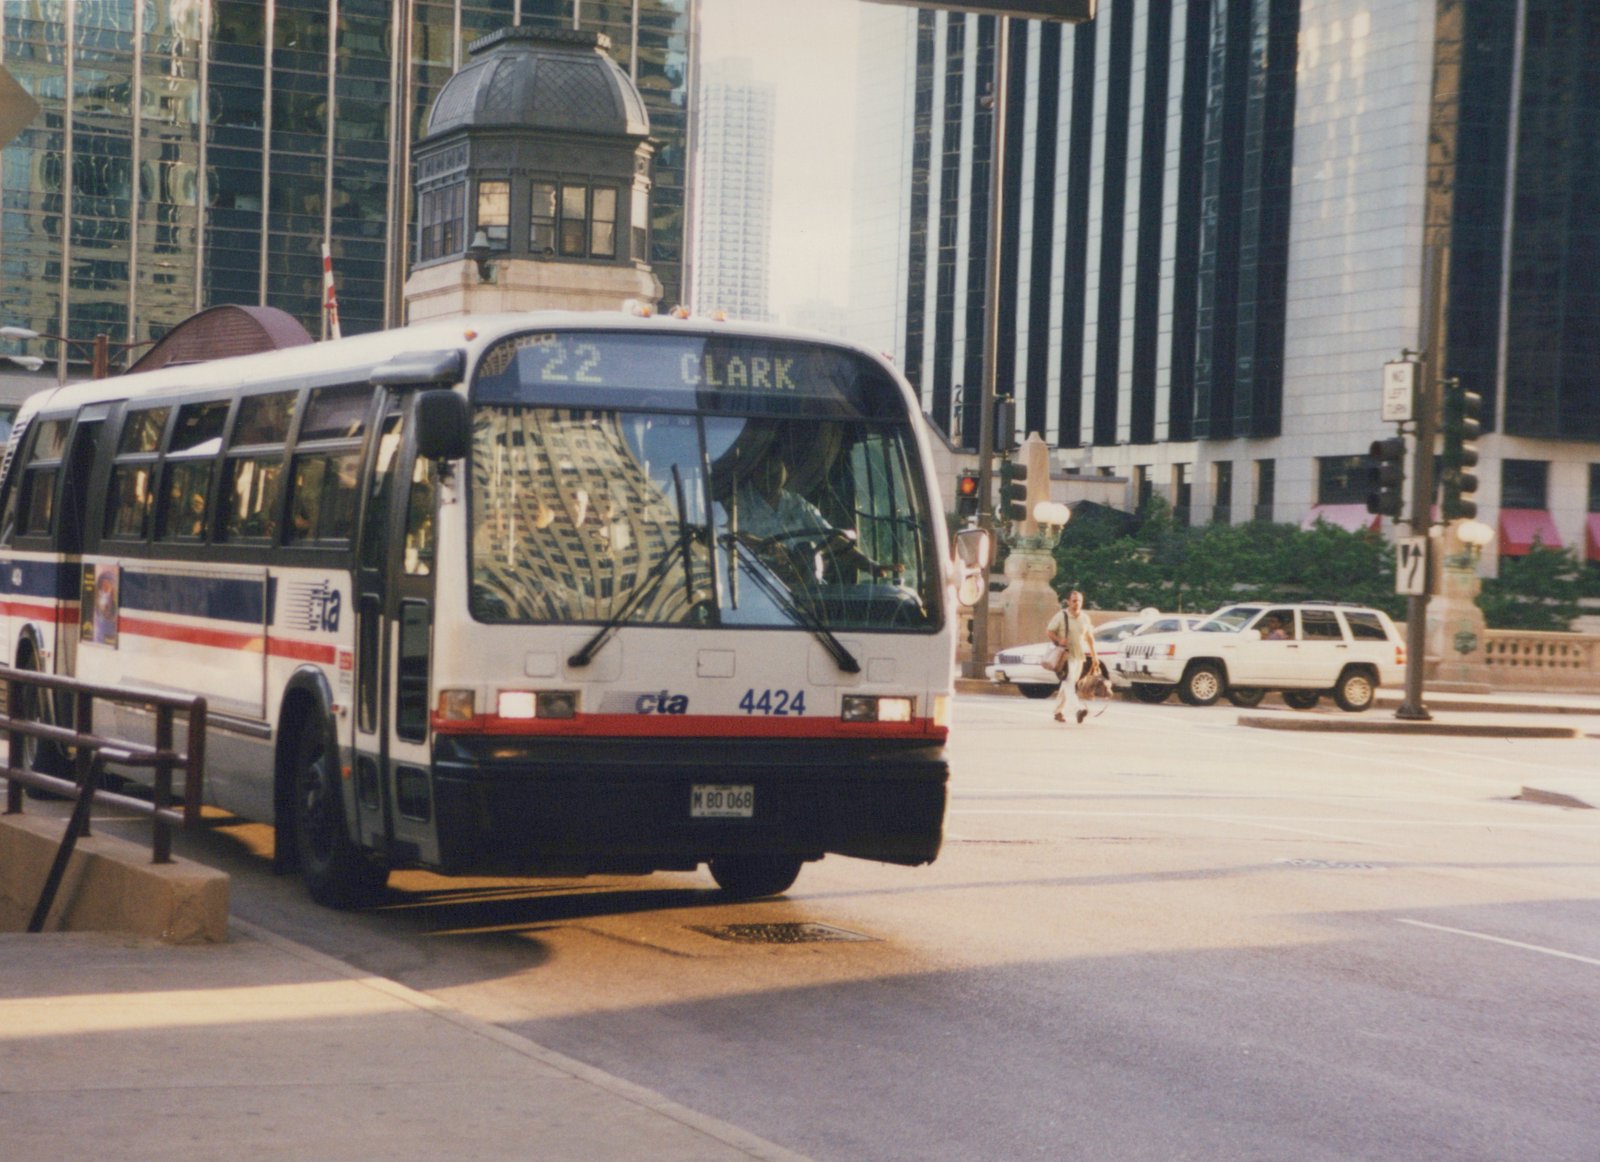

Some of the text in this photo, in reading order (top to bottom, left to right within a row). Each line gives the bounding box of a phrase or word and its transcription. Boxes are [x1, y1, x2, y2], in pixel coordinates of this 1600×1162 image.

[541, 342, 796, 390] 22 CLARK
[635, 690, 690, 715] cta
[739, 689, 806, 715] 4424
[694, 791, 703, 809] M
[727, 791, 752, 809] 068
